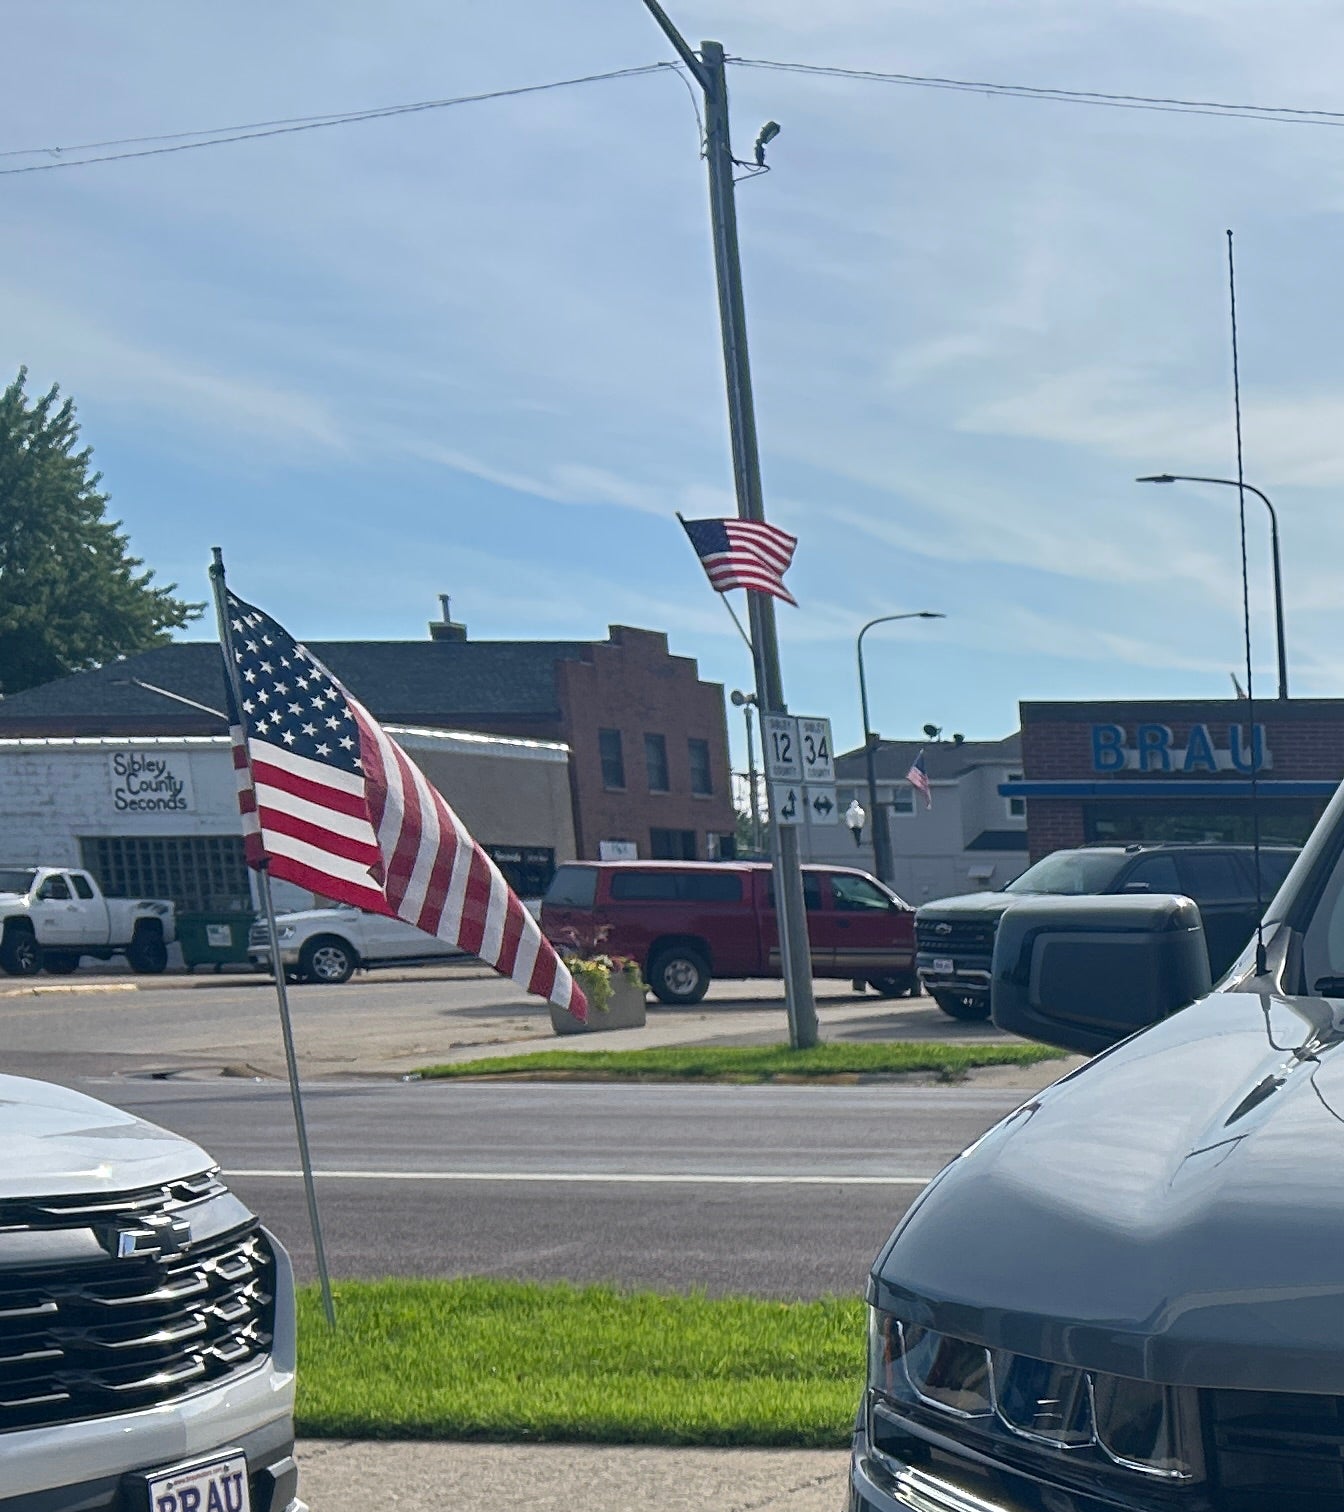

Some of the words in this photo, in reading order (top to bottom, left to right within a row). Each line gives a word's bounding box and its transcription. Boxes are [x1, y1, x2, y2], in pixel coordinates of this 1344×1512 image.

[772, 732, 793, 763] 12
[804, 735, 829, 766] 34
[1091, 723, 1266, 774] BRAU
[114, 753, 166, 778] Sibley
[125, 771, 184, 797] County
[114, 787, 188, 811] Seconds
